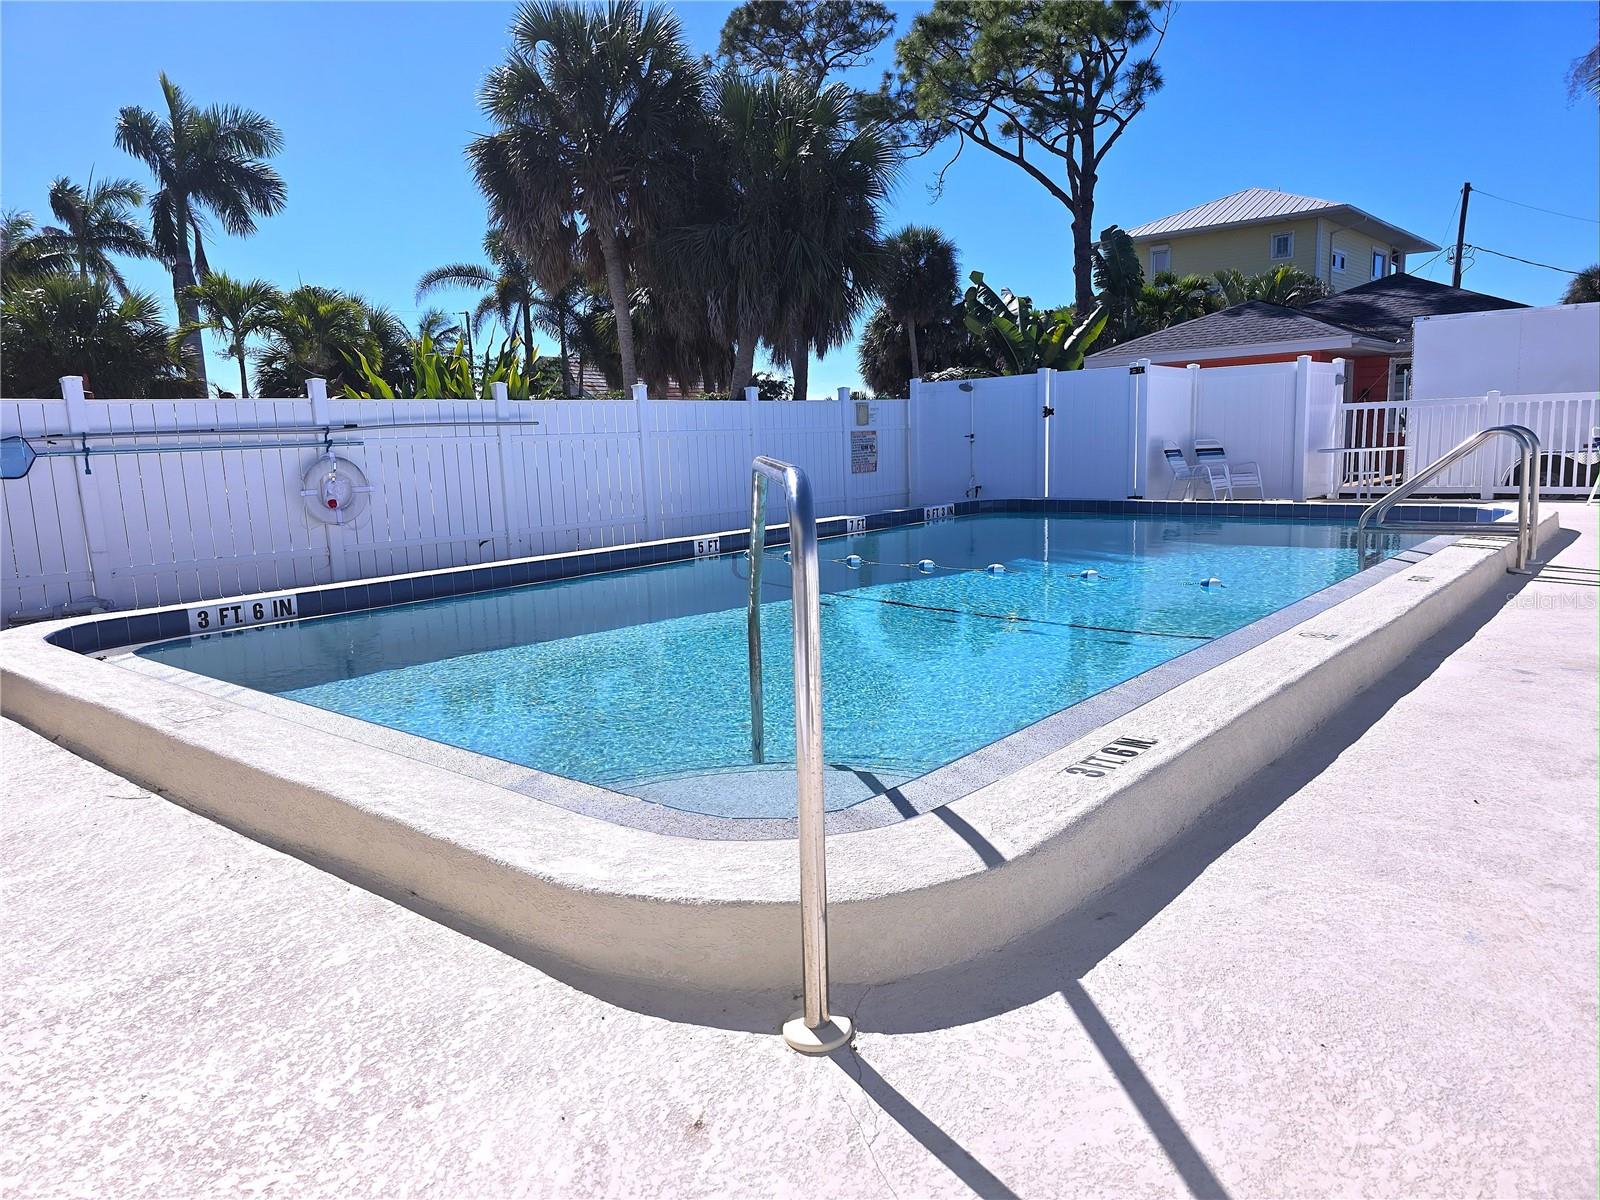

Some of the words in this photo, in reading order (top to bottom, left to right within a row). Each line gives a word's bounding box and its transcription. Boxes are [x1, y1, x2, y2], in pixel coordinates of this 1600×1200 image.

[698, 541, 704, 554] 5
[197, 610, 210, 629] 3
[219, 606, 243, 626] FT.
[252, 602, 265, 620] 6
[272, 598, 296, 618] IN.
[1066, 767, 1106, 778] 3
[1101, 747, 1139, 757] 6
